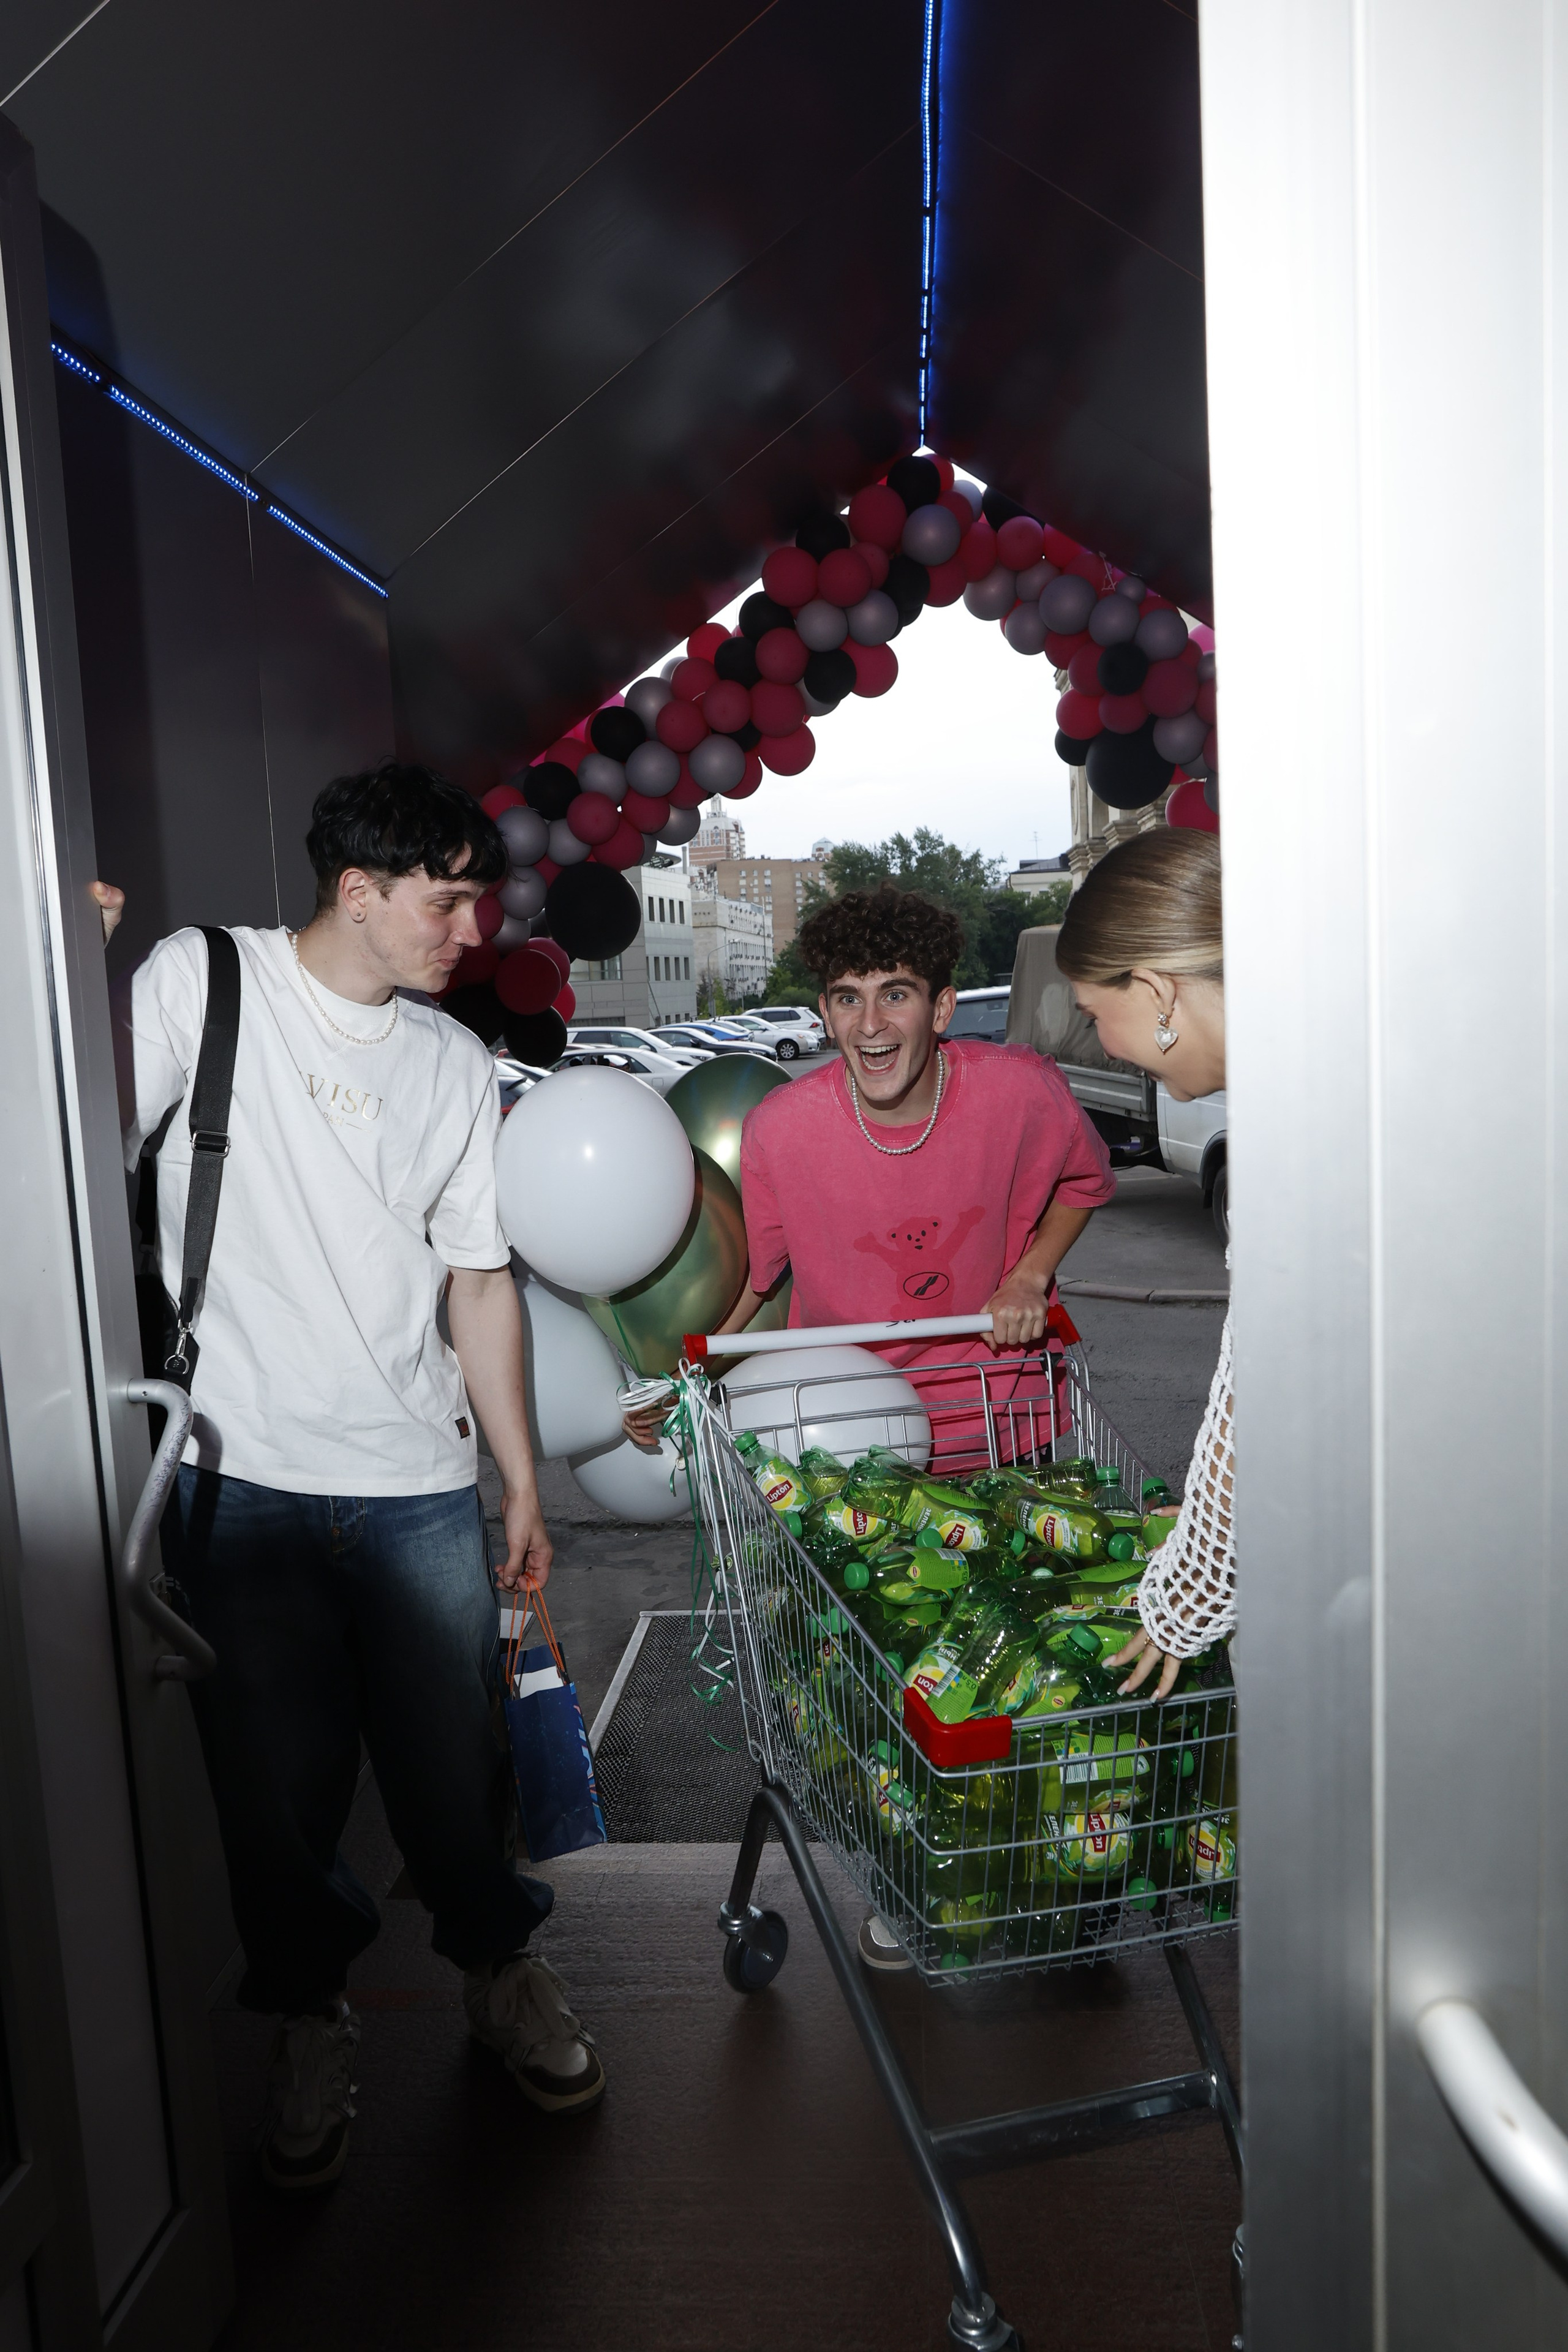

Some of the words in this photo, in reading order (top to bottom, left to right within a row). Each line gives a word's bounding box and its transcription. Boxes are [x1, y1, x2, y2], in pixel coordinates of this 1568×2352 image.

[305, 1073, 383, 1120] VISU
[766, 1483, 790, 1502] Lipton
[856, 1512, 866, 1534] Lipto
[1046, 1519, 1054, 1546] Lipton
[918, 1677, 934, 1692] ton
[1191, 1838, 1215, 1859] iptn
